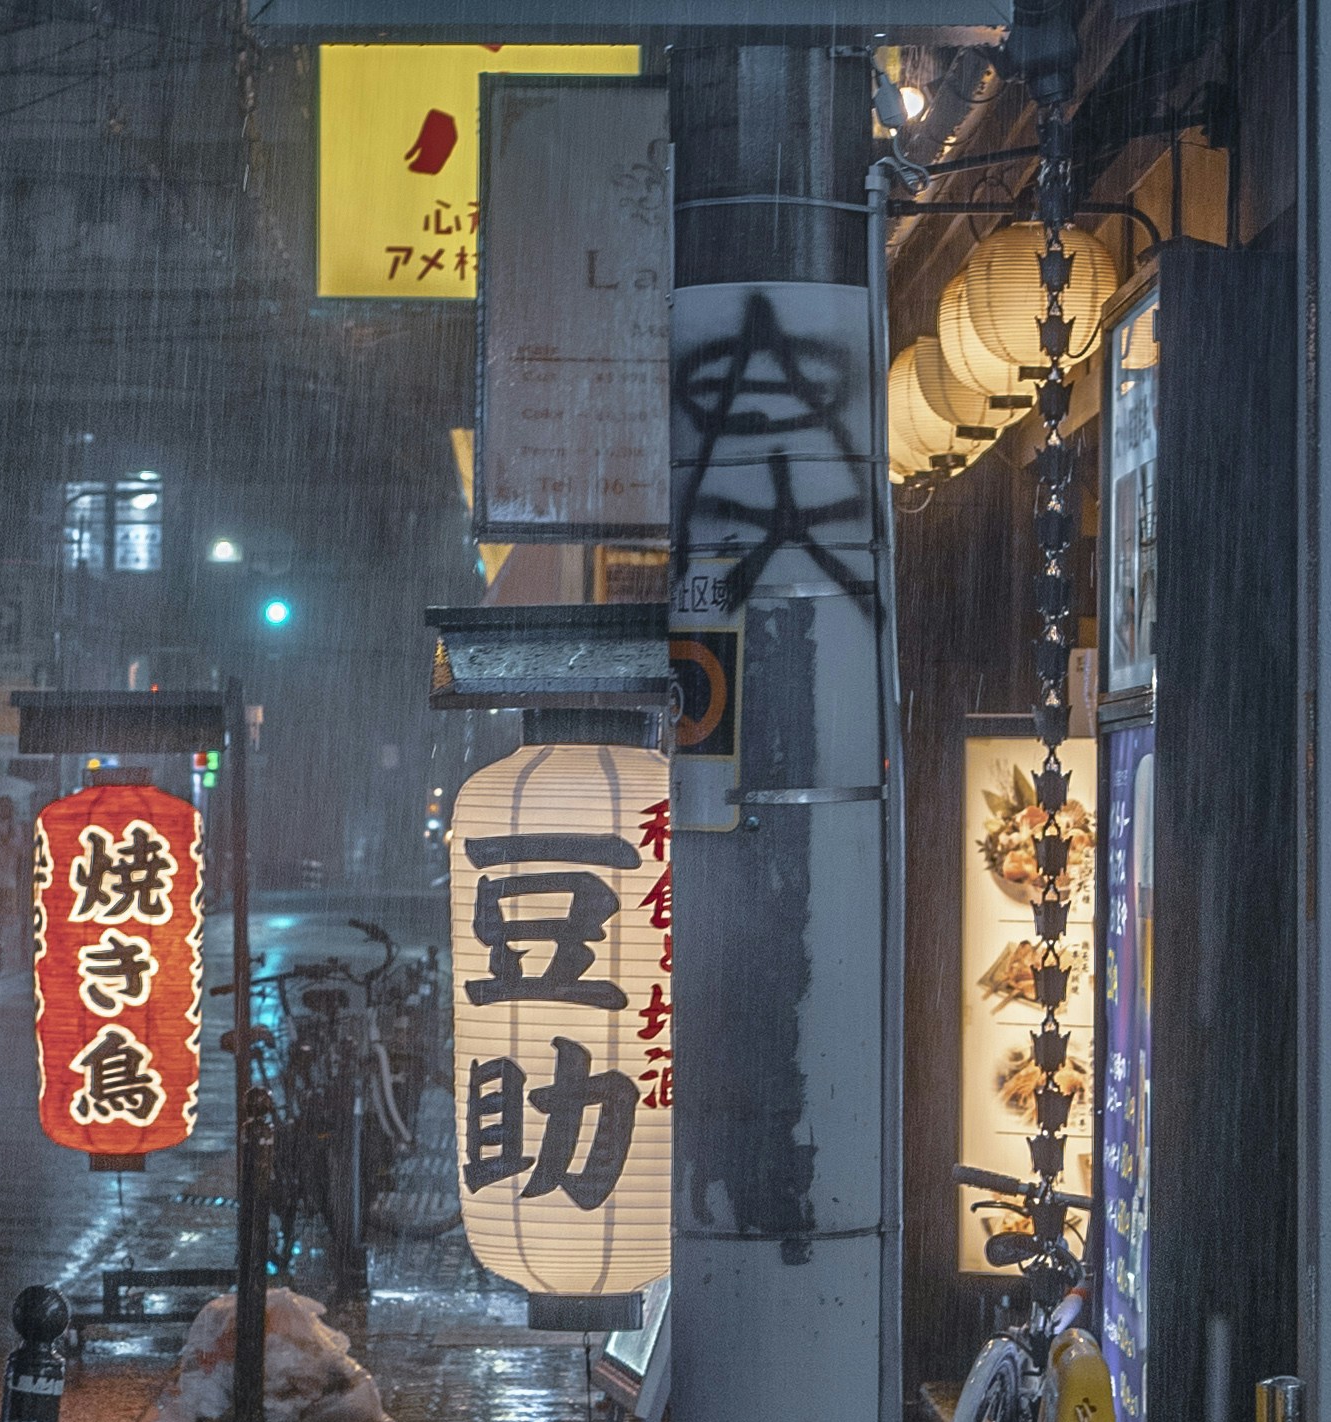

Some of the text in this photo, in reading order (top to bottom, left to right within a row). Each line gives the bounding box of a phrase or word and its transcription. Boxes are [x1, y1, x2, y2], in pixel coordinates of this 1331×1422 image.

[72, 823, 176, 1125] 焼き鳥
[463, 833, 642, 1210] 豆助
